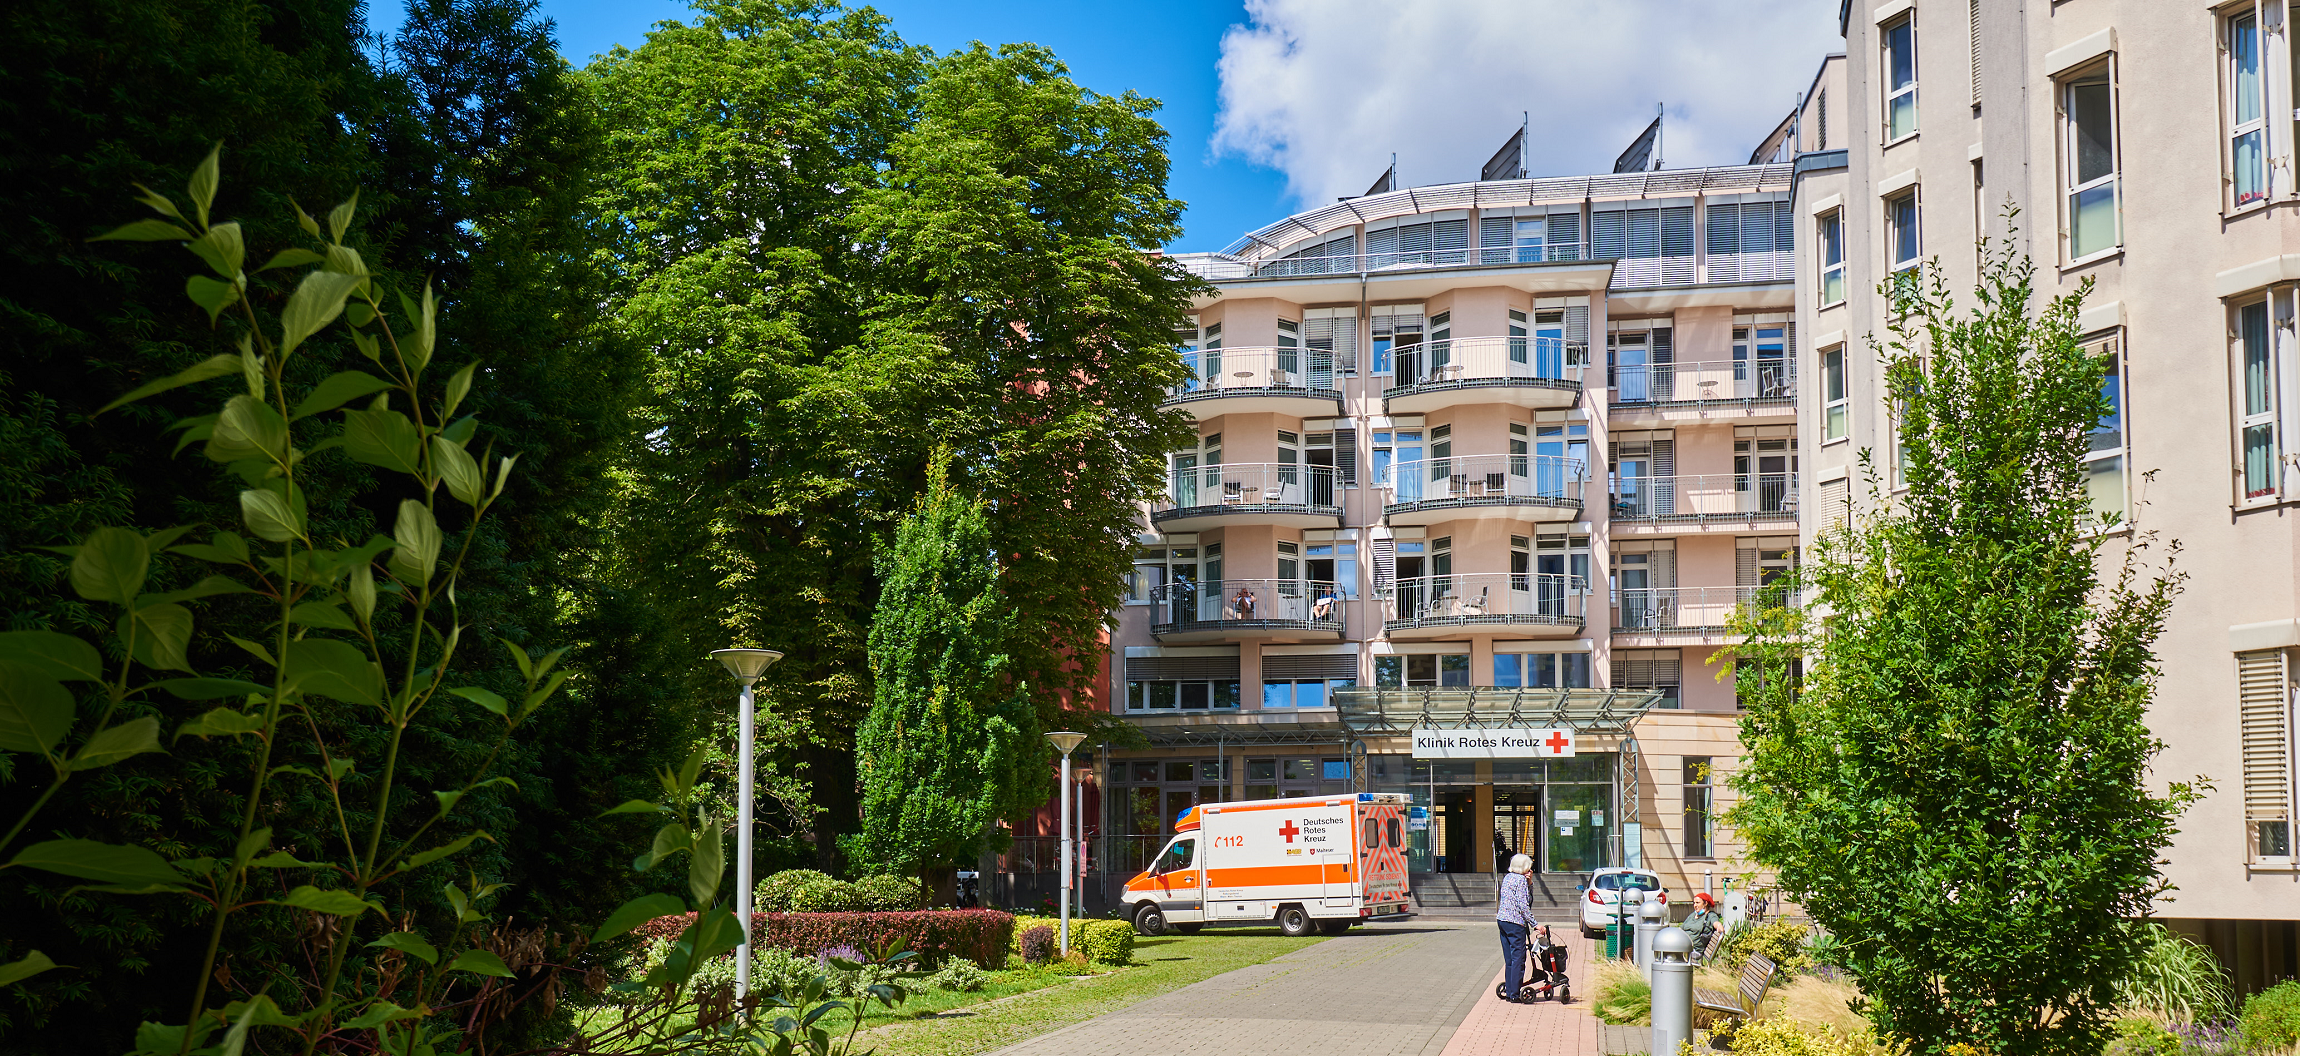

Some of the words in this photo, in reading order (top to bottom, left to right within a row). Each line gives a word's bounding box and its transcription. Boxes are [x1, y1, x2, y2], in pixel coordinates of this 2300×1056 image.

[1418, 737, 1455, 748] Klinik
[1459, 737, 1497, 748] Rotes
[1501, 736, 1540, 747] Kreuz
[1303, 817, 1344, 826] Deutsches
[1303, 827, 1326, 835] Rotes
[1223, 835, 1244, 847] 112
[1304, 835, 1327, 843] Kreuz
